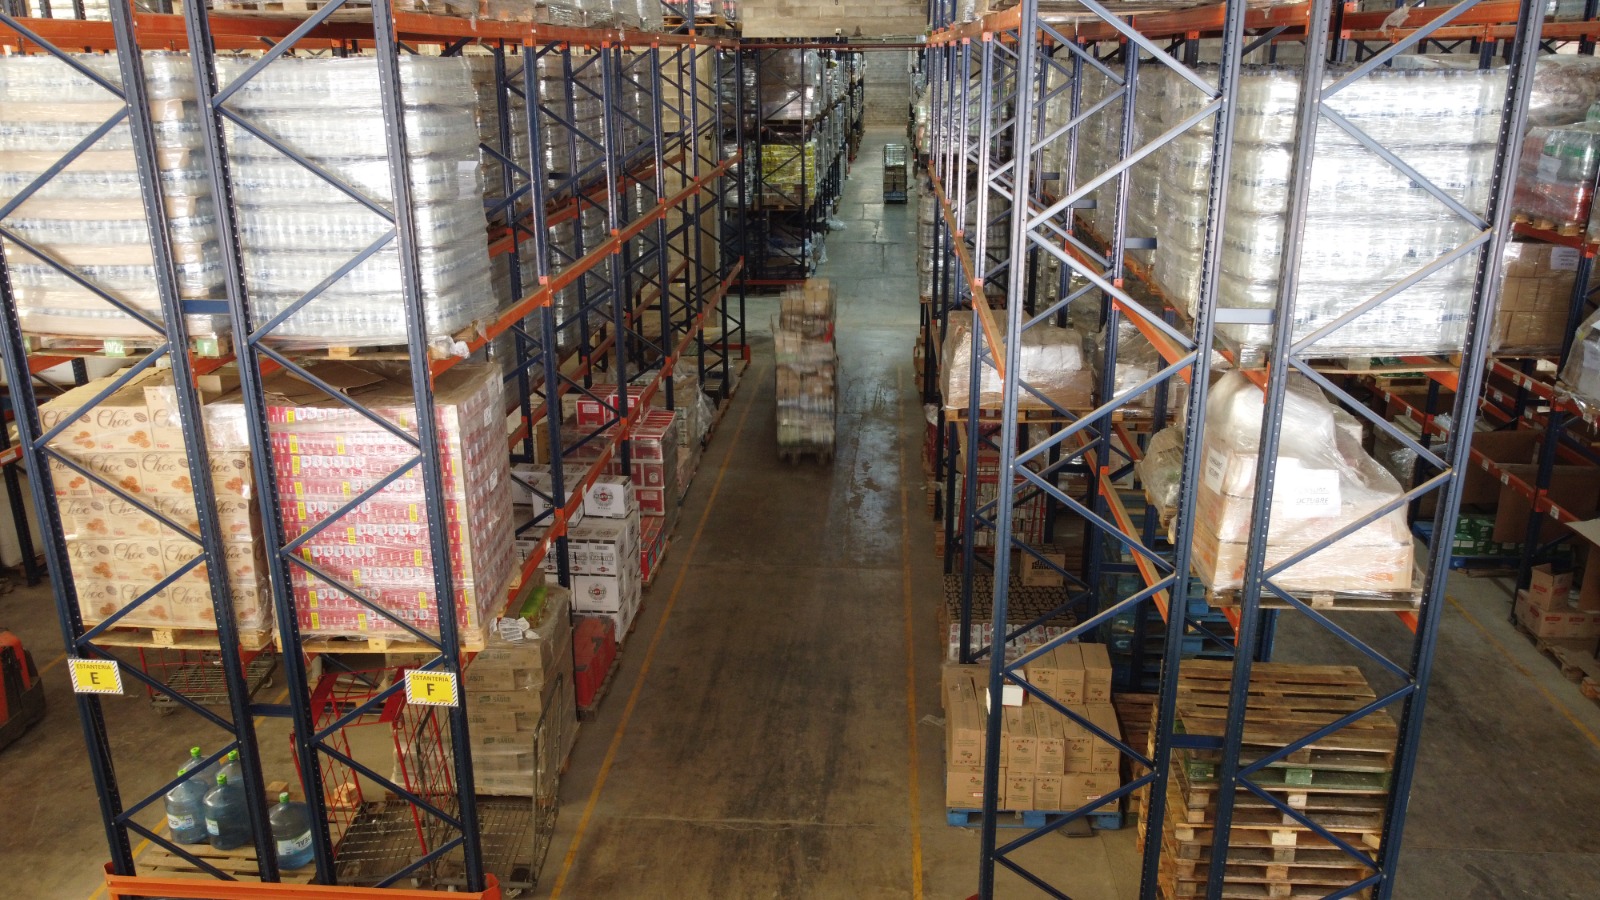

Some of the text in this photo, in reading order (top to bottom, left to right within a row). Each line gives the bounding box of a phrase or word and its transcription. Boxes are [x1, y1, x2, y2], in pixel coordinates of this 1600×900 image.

[97, 409, 132, 429] Choc
[142, 453, 177, 473] Choc
[209, 457, 232, 473] hoc
[217, 500, 238, 515] hoc
[114, 543, 146, 561] Choc
[172, 586, 204, 605] Choc
[90, 671, 101, 685] E
[427, 683, 436, 696] F
